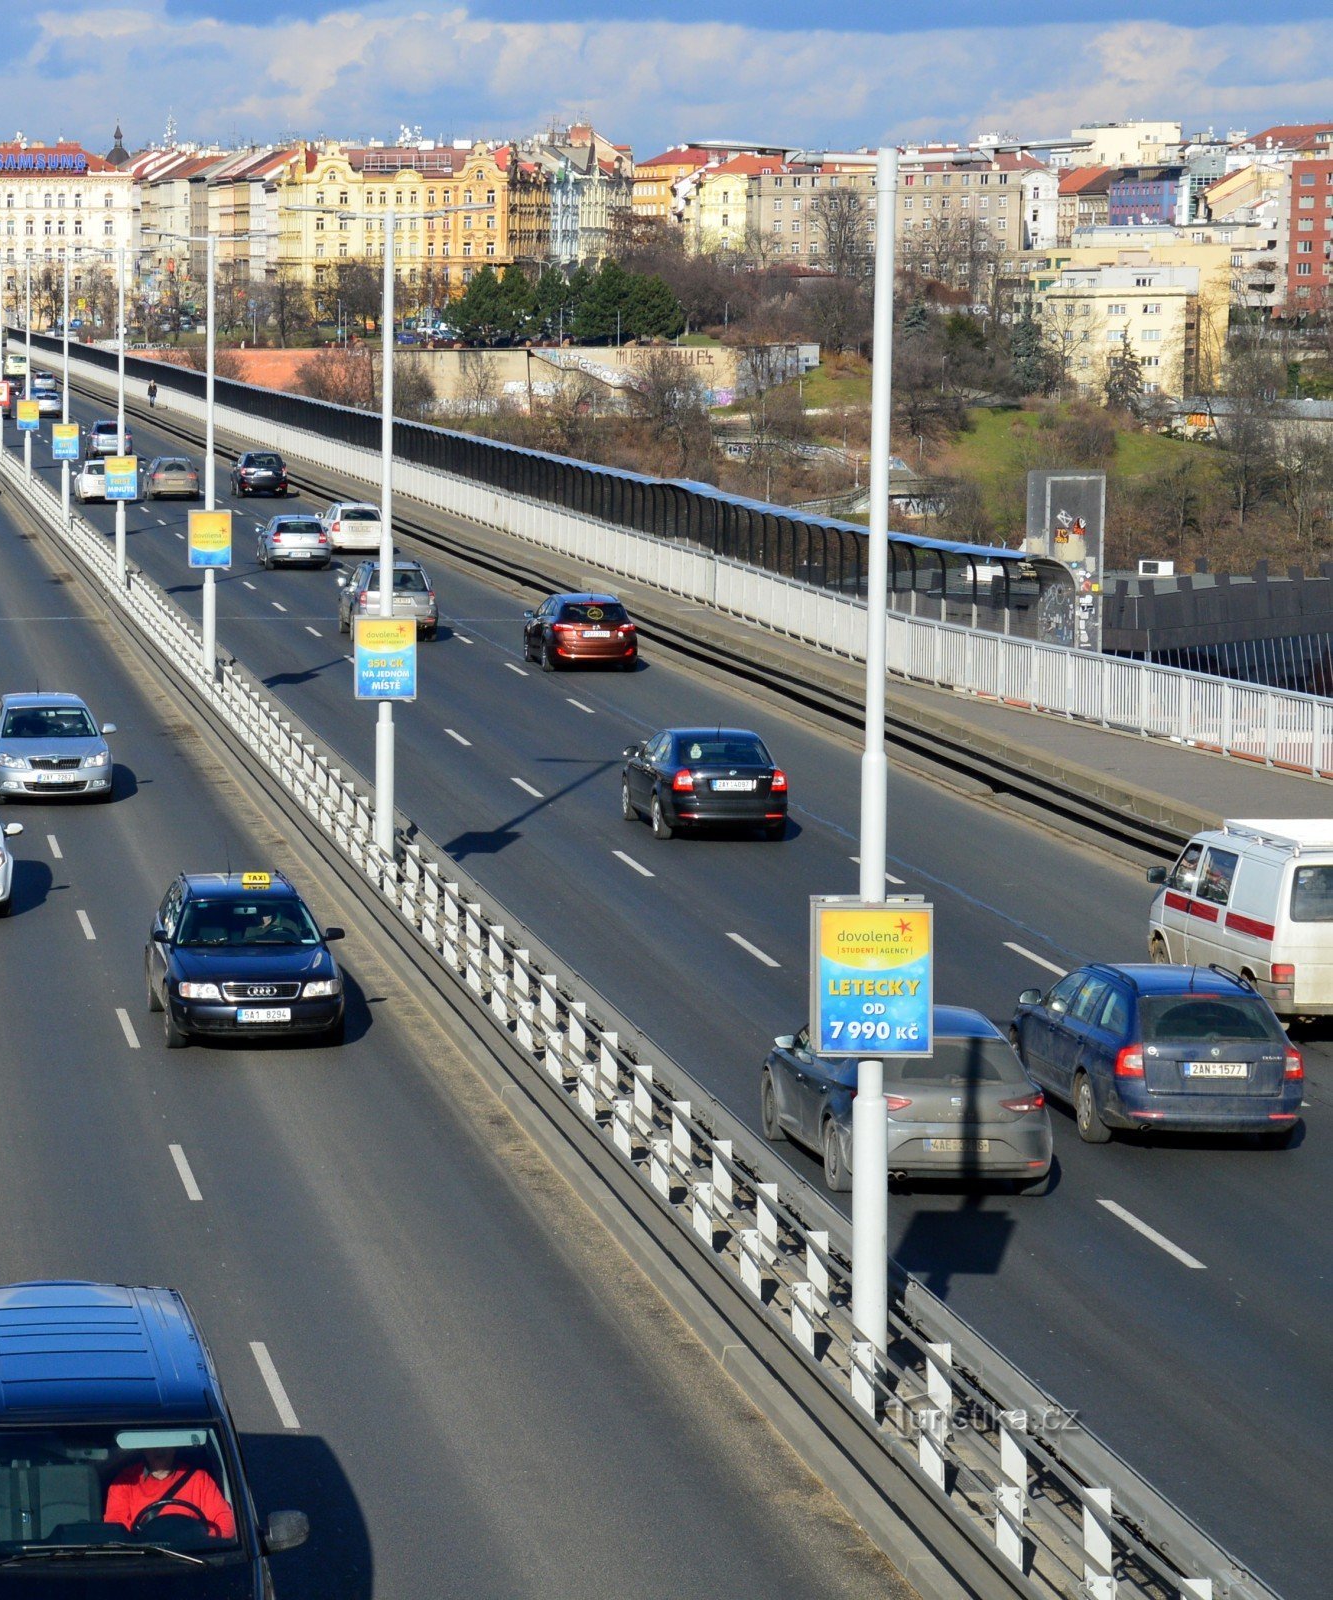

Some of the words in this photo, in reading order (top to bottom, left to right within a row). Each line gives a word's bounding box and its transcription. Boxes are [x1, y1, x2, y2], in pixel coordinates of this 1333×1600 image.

[362, 670, 375, 678] NA
[376, 670, 410, 678] JEDNOM
[248, 874, 267, 882] TAXI
[841, 947, 875, 955] STUDENT
[828, 979, 921, 997] LETECKY
[862, 1002, 886, 1015] OD
[244, 1010, 260, 1019] 5A1
[267, 1009, 287, 1018] 8294
[1192, 1064, 1211, 1074] 2AN
[1219, 1064, 1242, 1074] 1577
